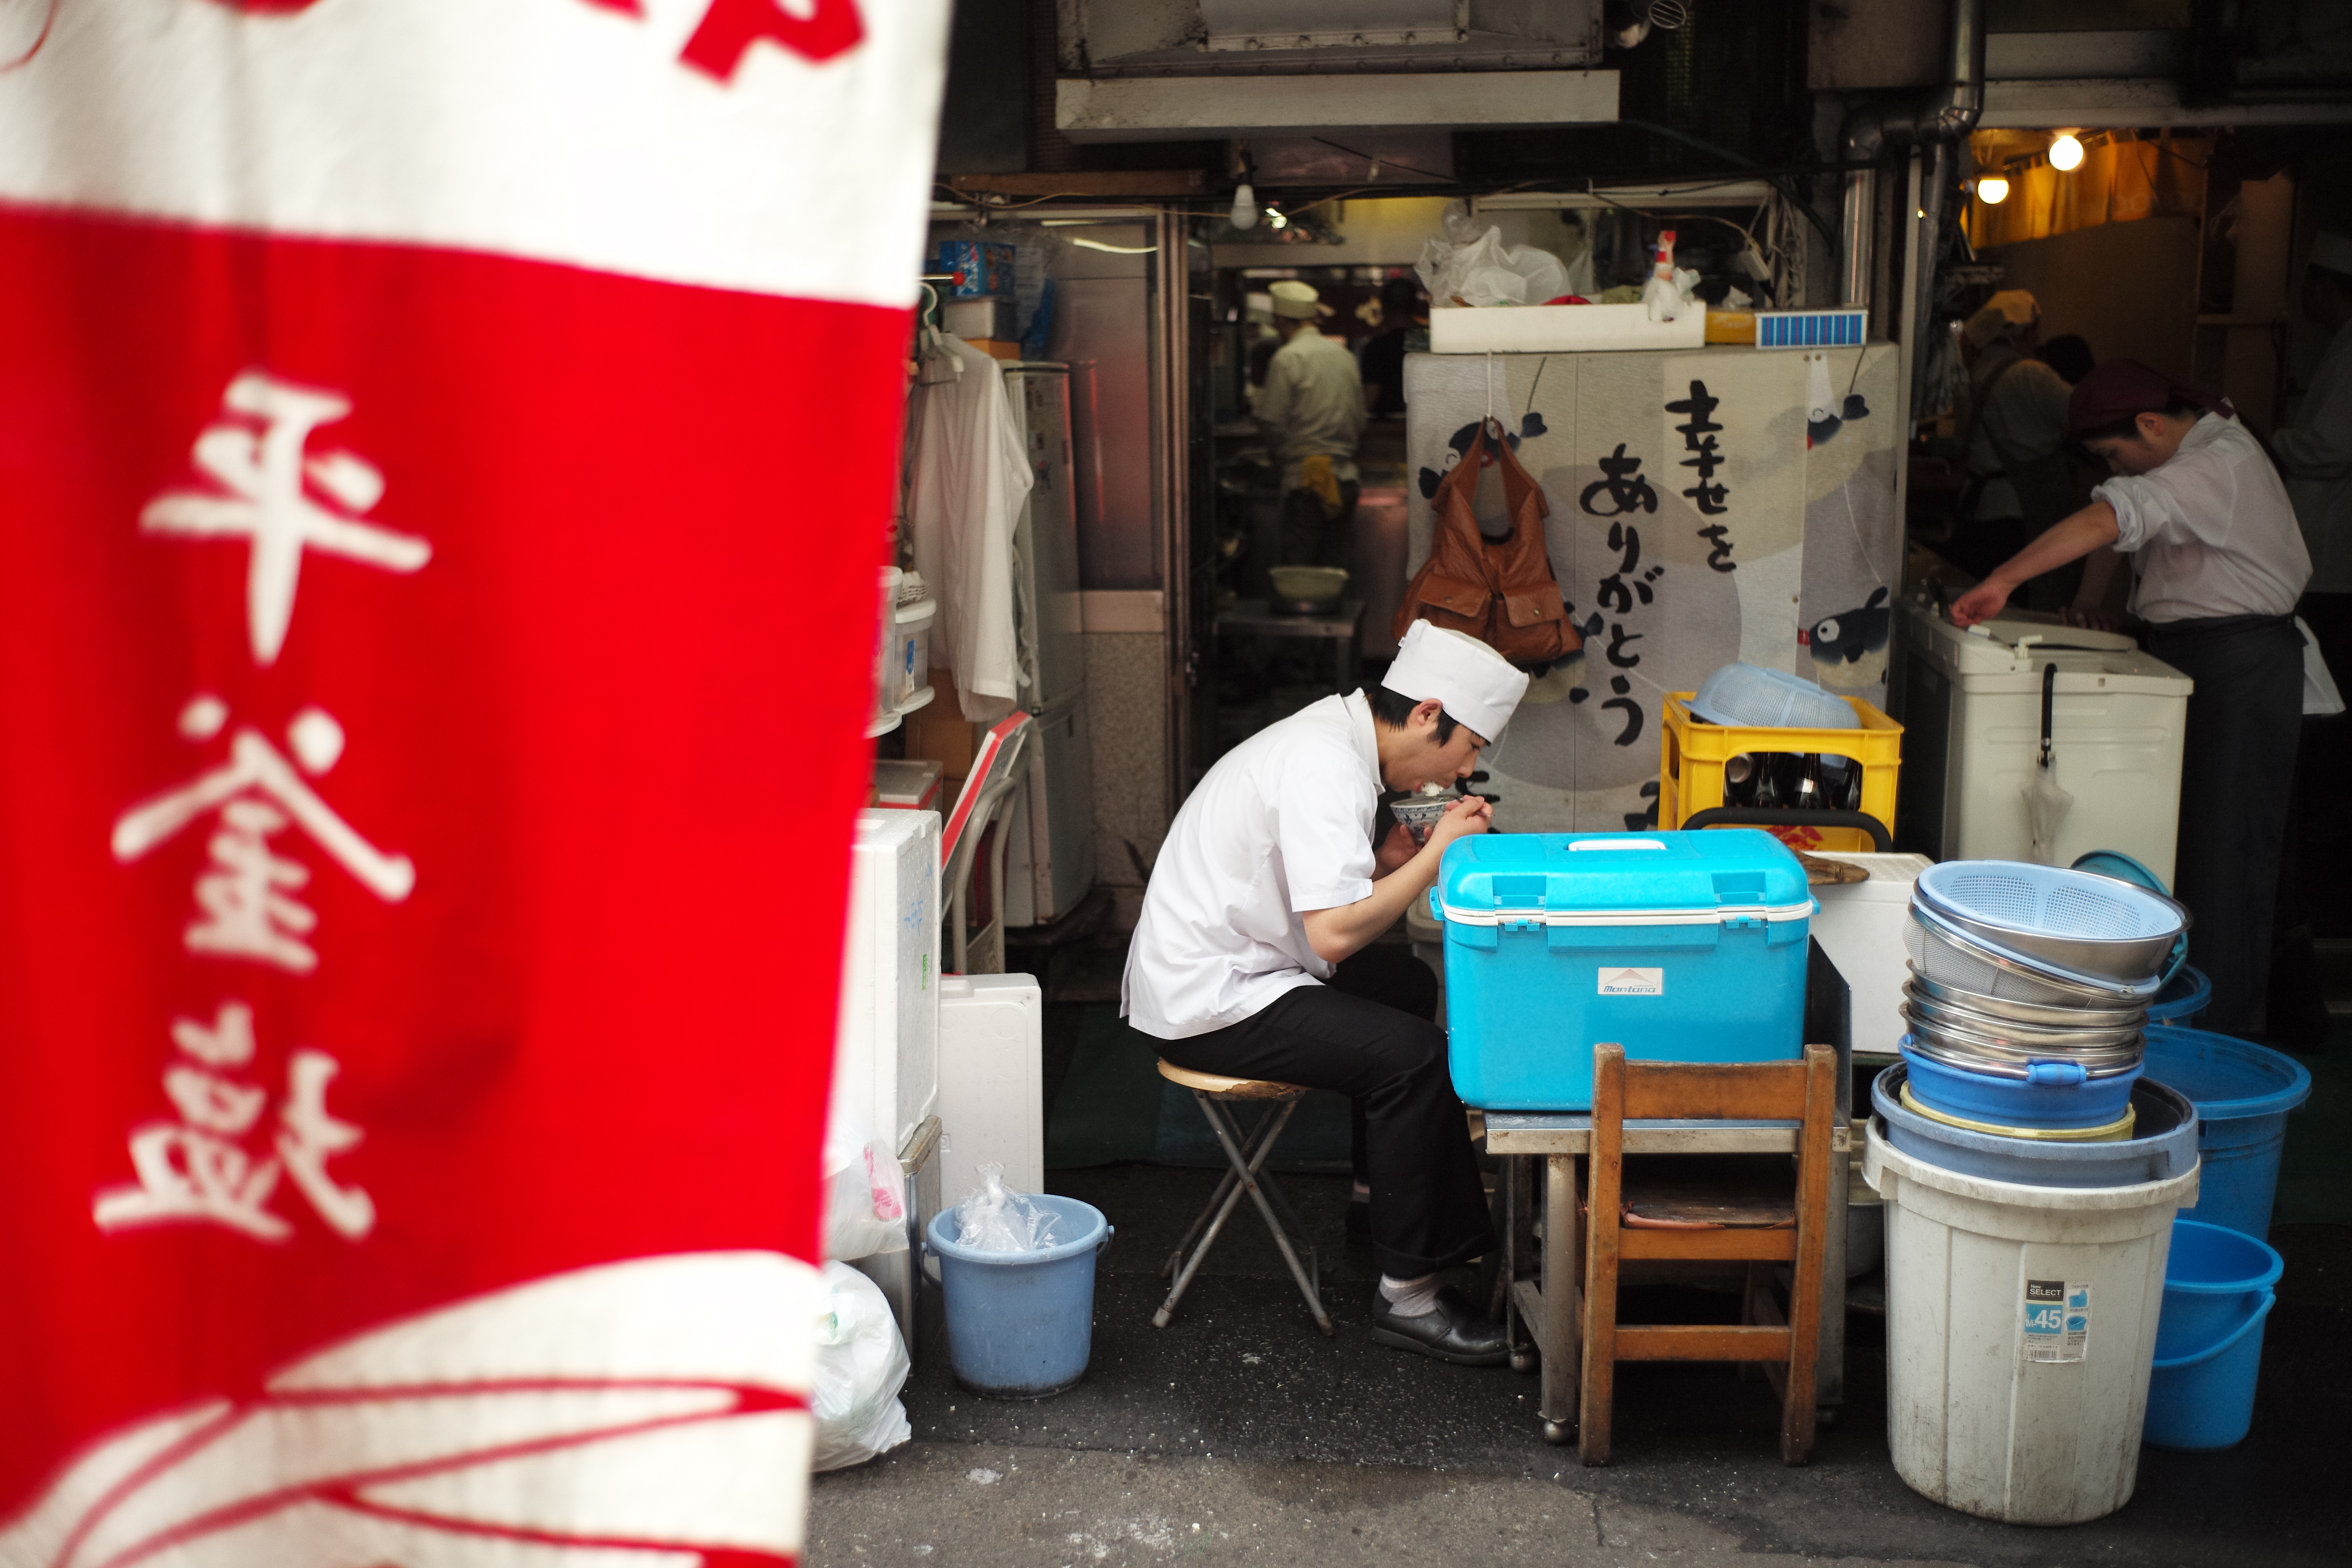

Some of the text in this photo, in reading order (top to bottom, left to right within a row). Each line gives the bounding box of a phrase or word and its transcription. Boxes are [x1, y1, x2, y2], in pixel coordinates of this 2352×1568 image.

[1579, 443, 1664, 747] ありがとう
[1664, 379, 1737, 573] 幸せを
